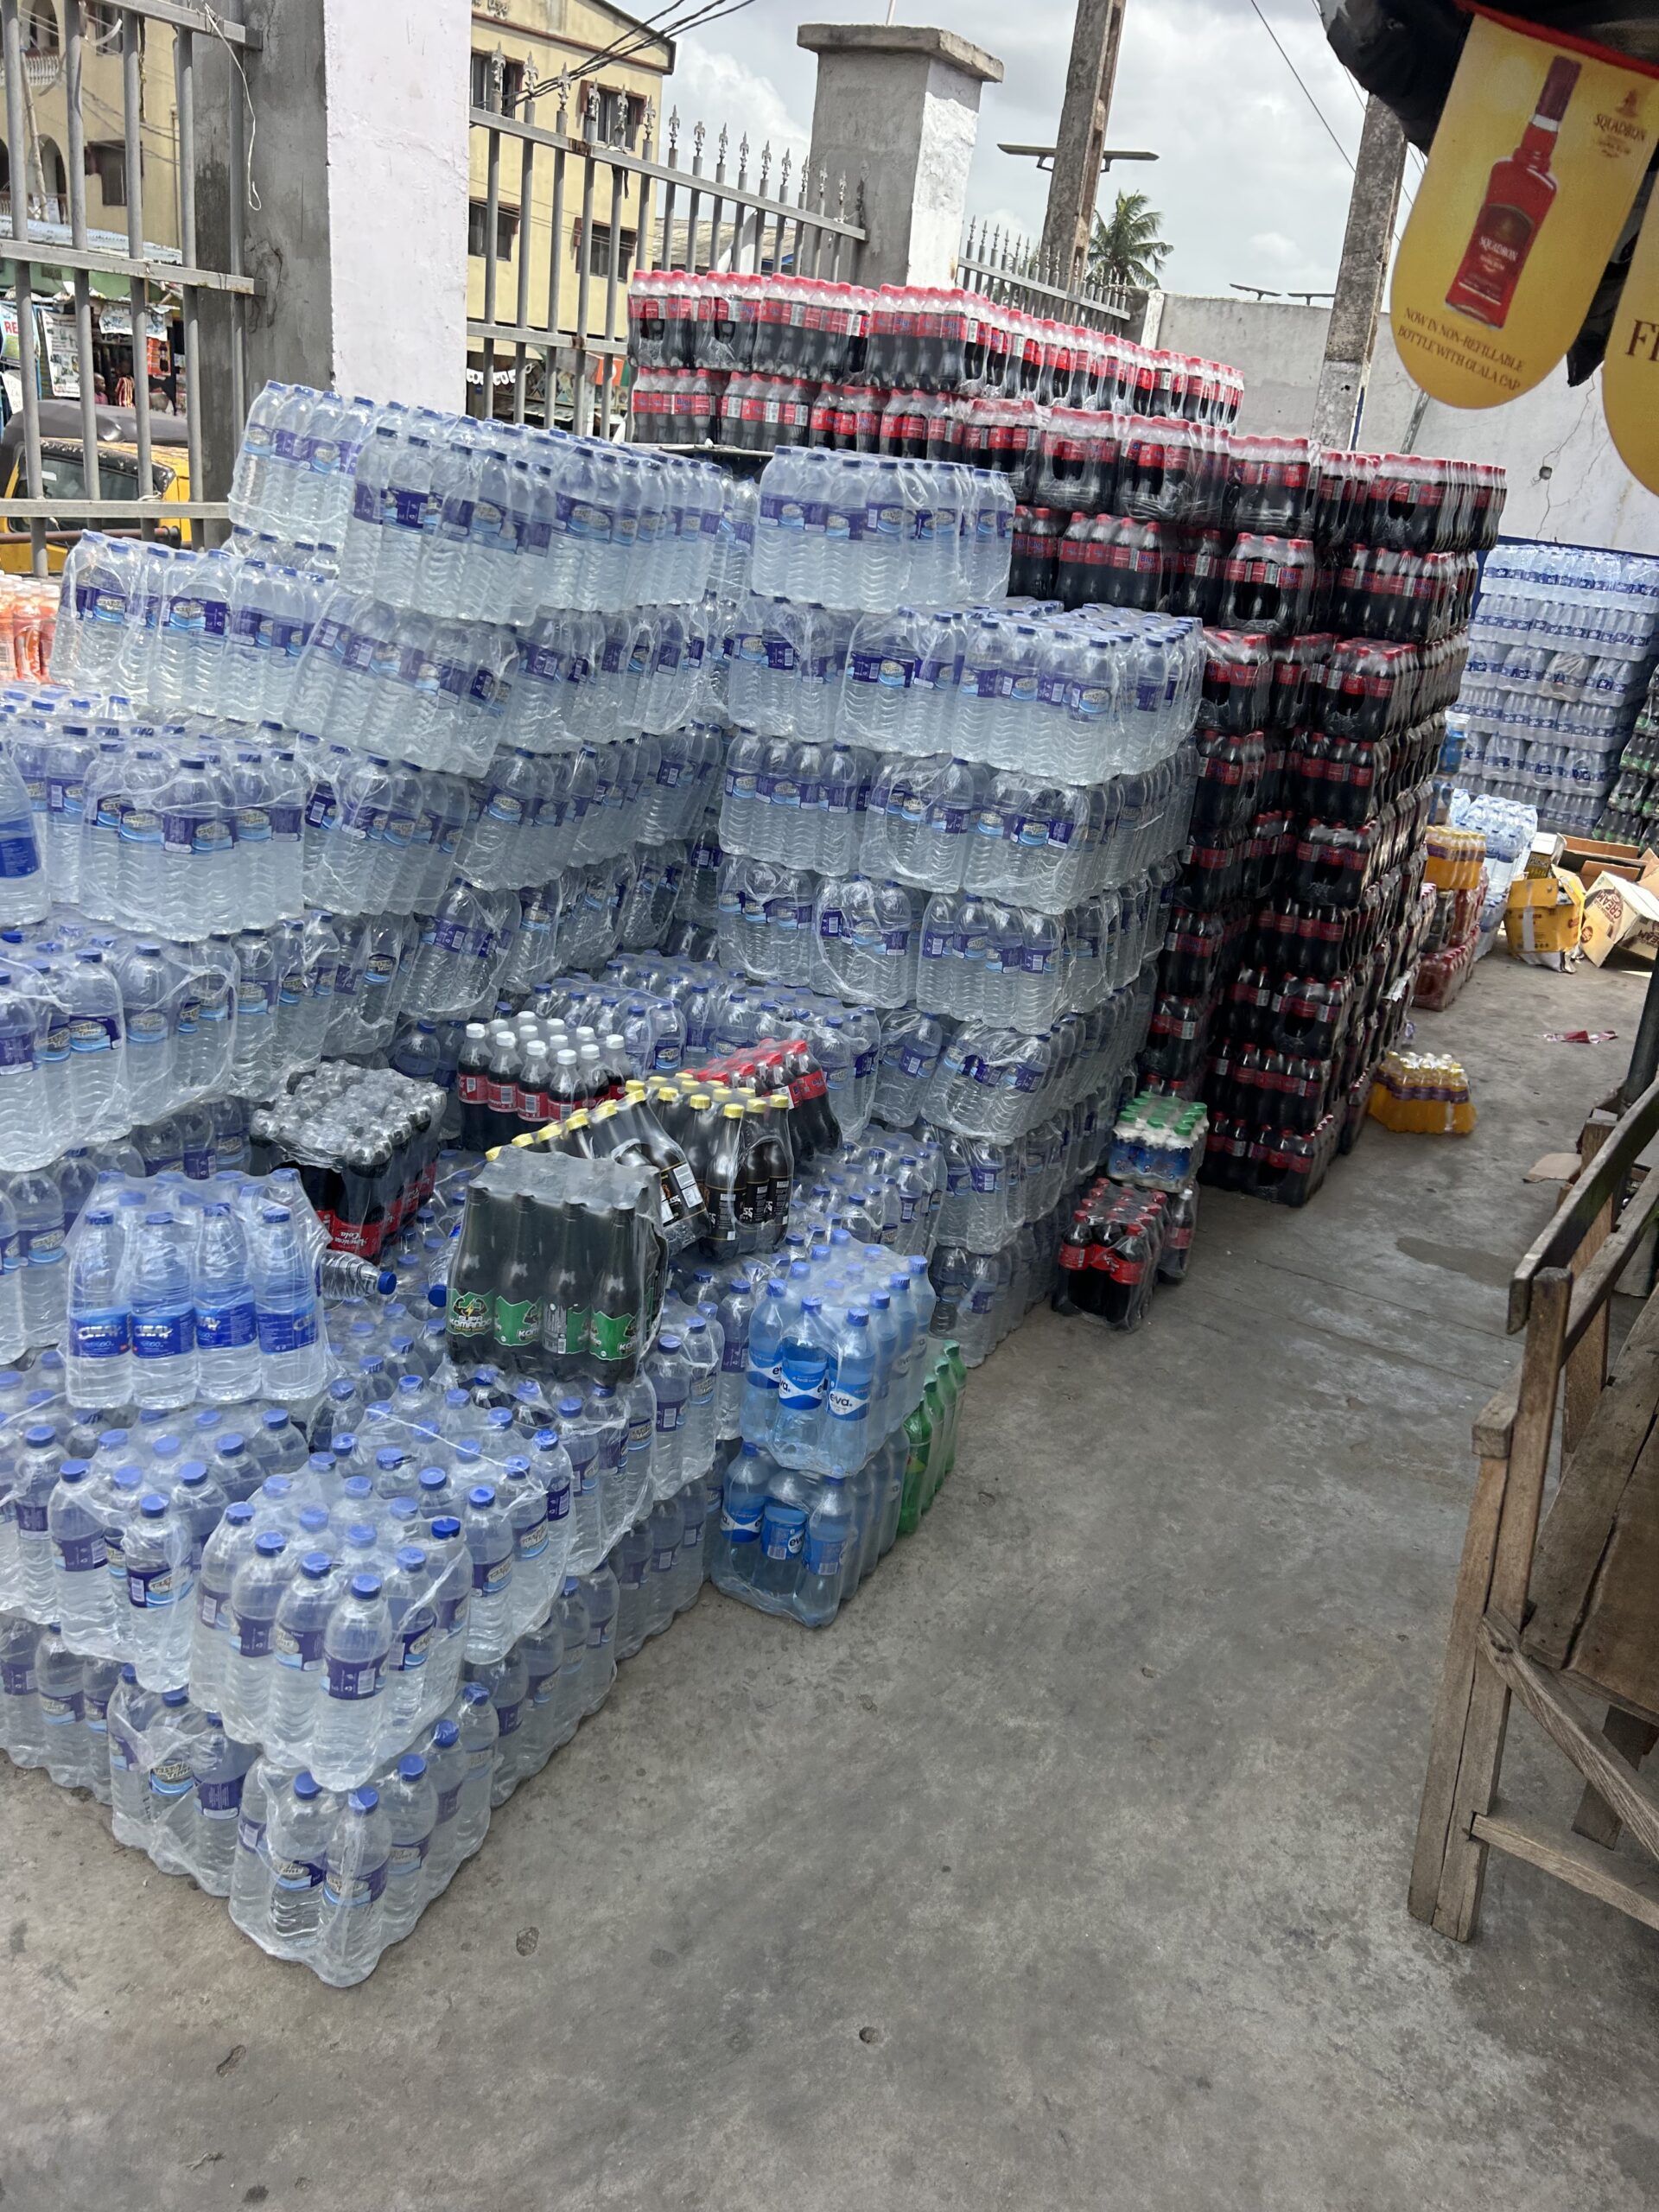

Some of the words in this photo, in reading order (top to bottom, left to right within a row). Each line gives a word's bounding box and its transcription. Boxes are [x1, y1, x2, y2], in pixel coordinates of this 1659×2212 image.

[1398, 324, 1435, 353] BOTTLE
[1436, 343, 1465, 367] WITH
[1499, 373, 1522, 391] CAP
[1404, 307, 1427, 326] NOW
[1427, 318, 1439, 333] IN
[1440, 324, 1525, 372] NON-REFILLABLE
[1595, 890, 1623, 918] CREAM
